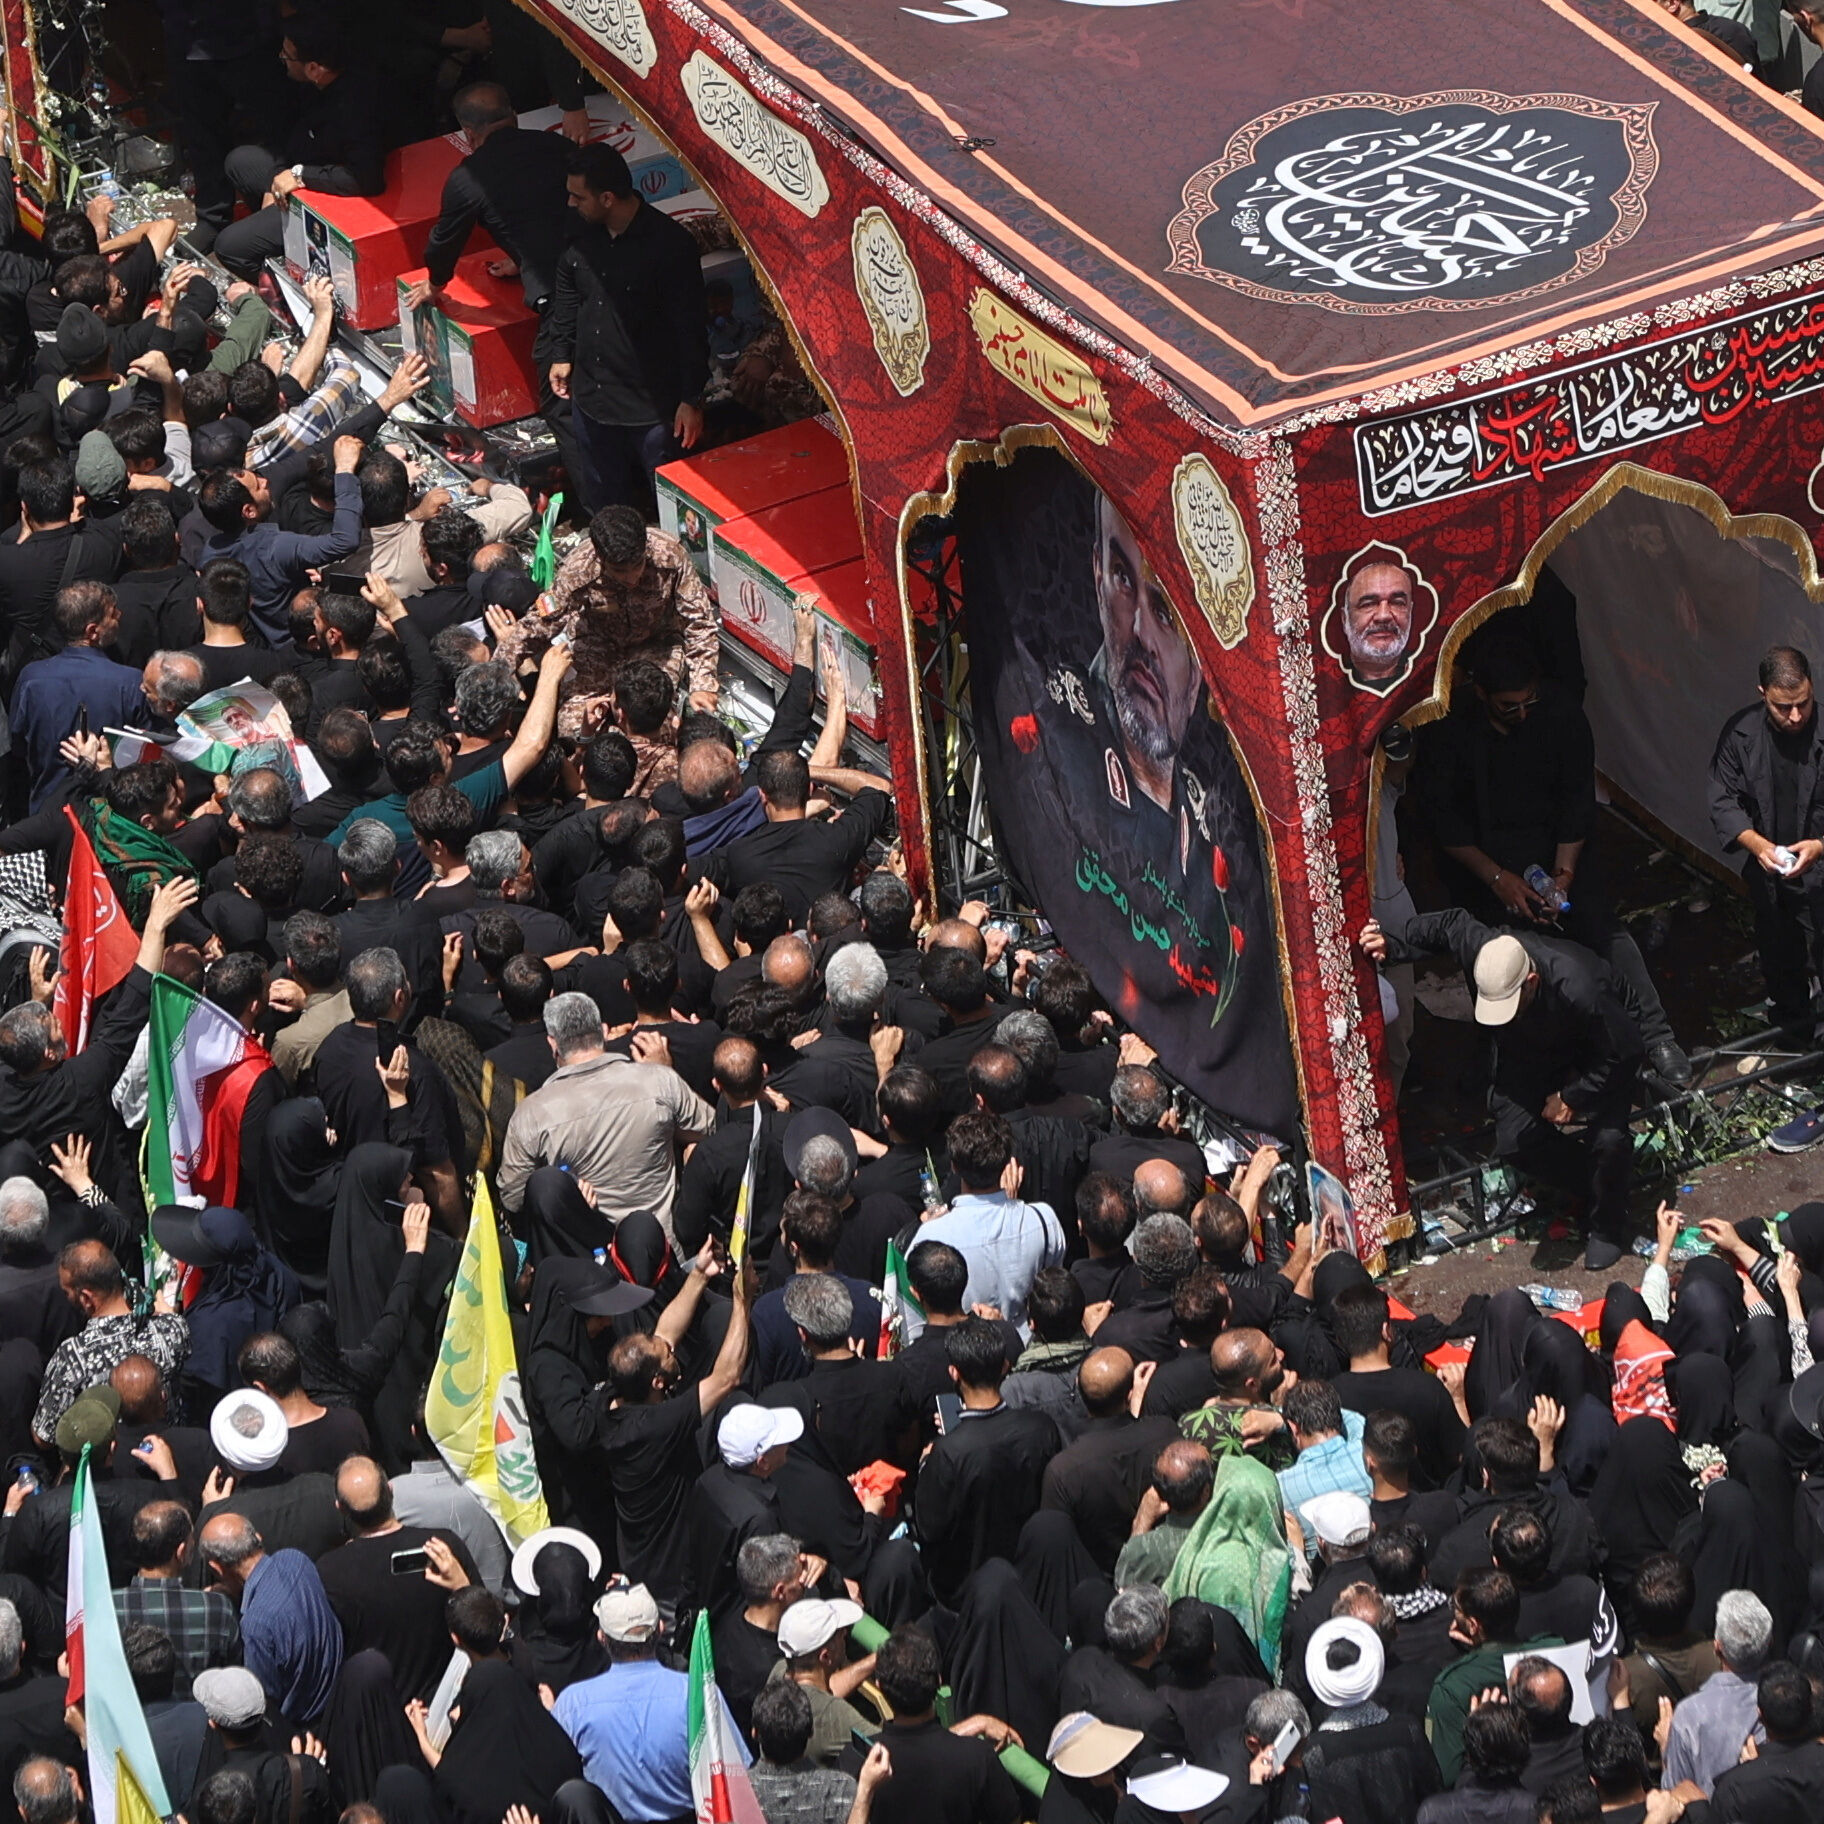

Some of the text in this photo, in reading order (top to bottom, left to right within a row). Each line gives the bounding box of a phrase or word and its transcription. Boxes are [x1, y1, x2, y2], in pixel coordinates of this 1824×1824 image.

[1075, 846, 1219, 997] شهید حسن محقق
